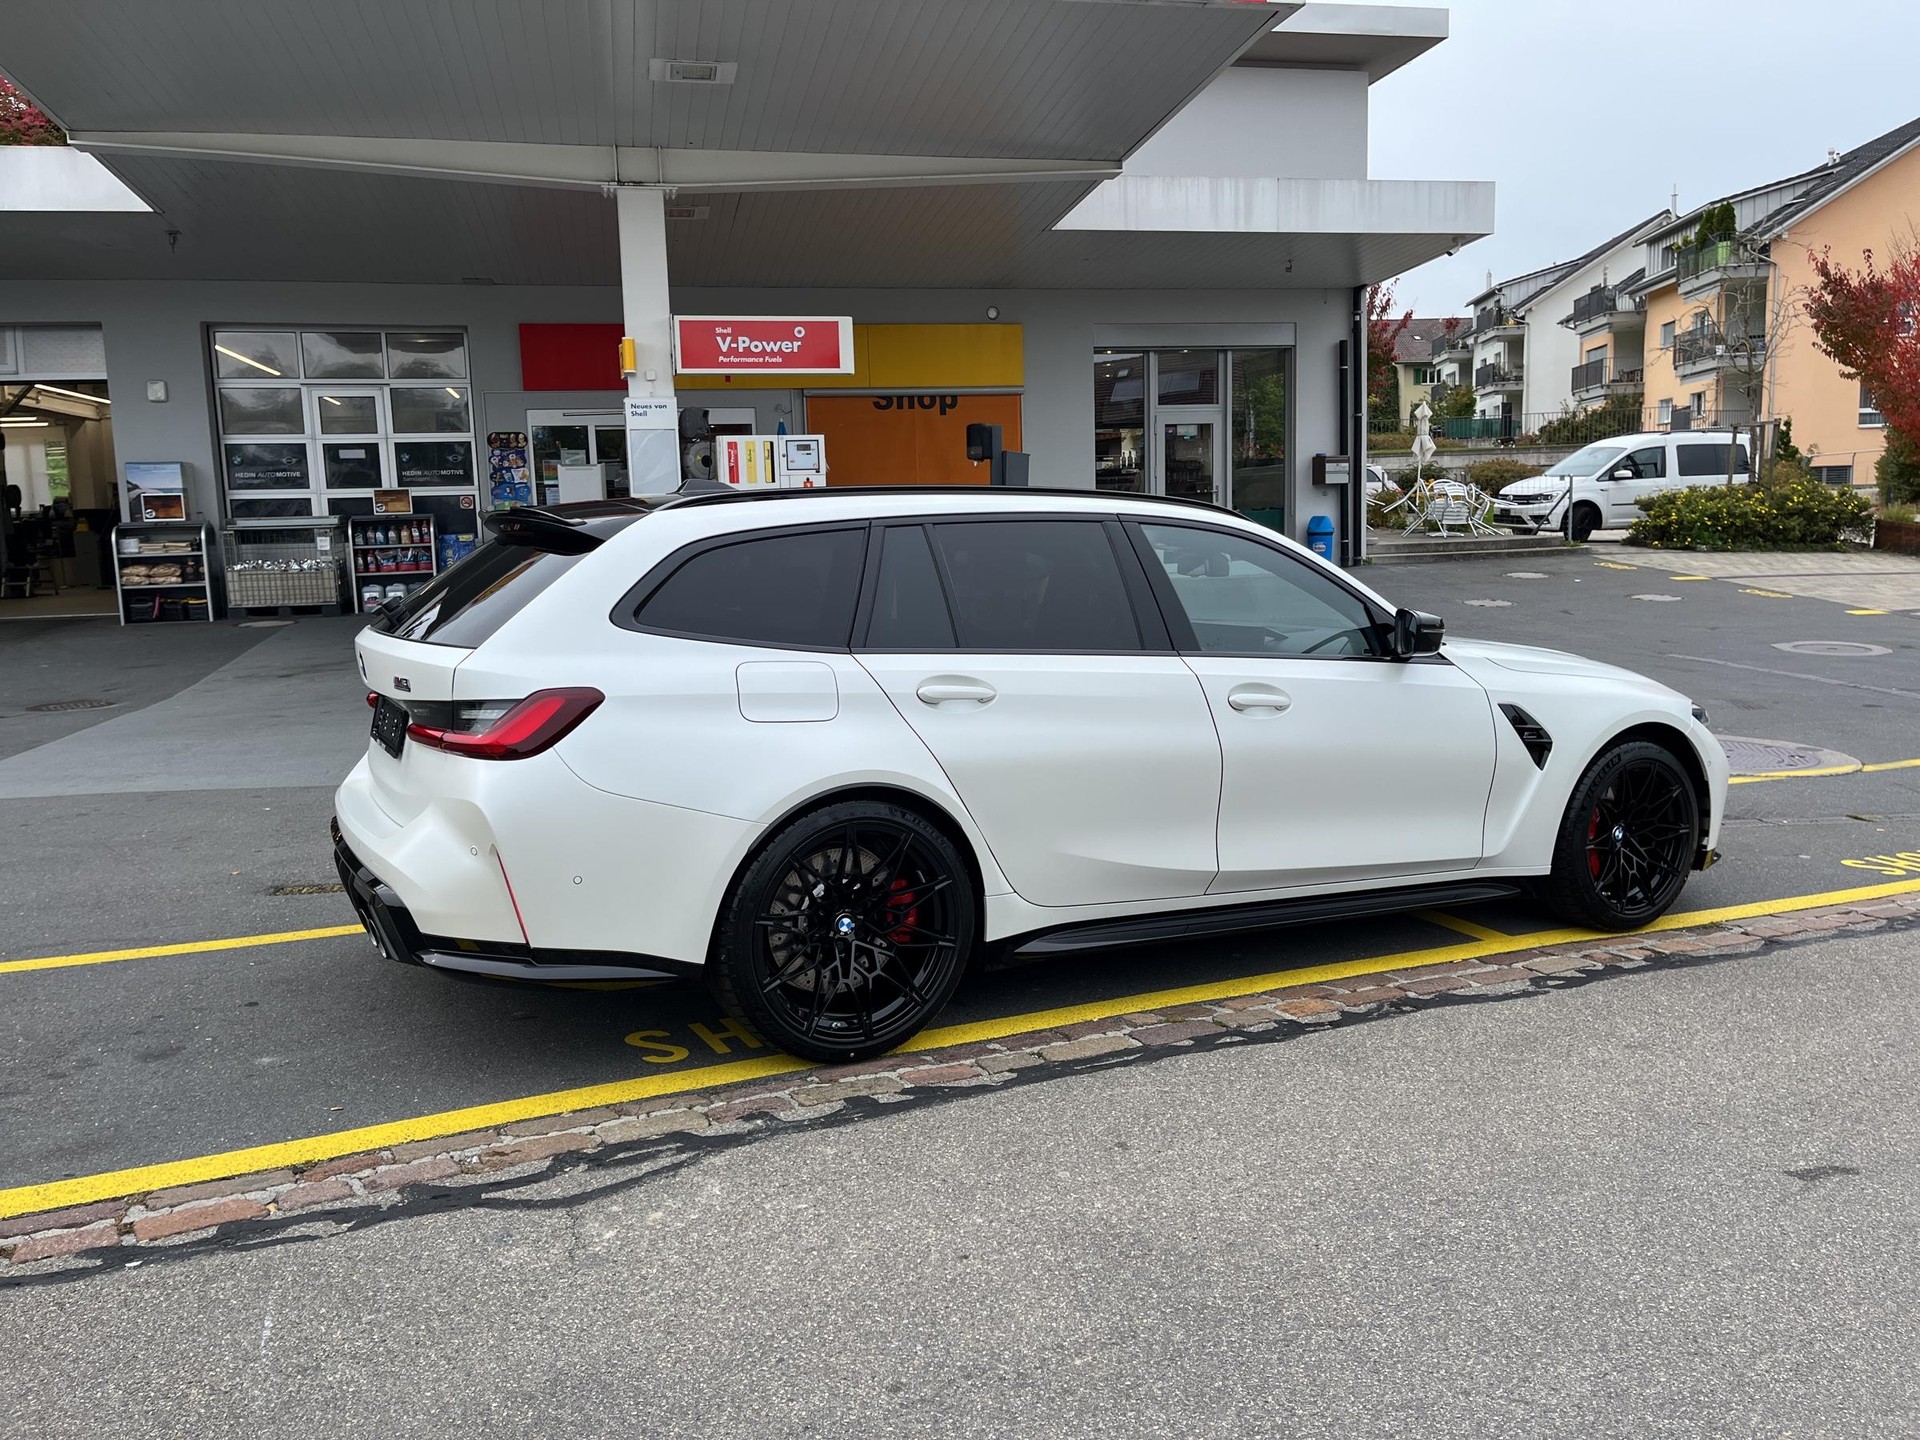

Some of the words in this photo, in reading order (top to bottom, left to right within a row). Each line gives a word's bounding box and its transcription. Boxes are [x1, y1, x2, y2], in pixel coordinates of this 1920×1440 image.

[715, 336, 802, 353] V-Power
[718, 355, 764, 364] Performance
[764, 355, 783, 363] Fuels
